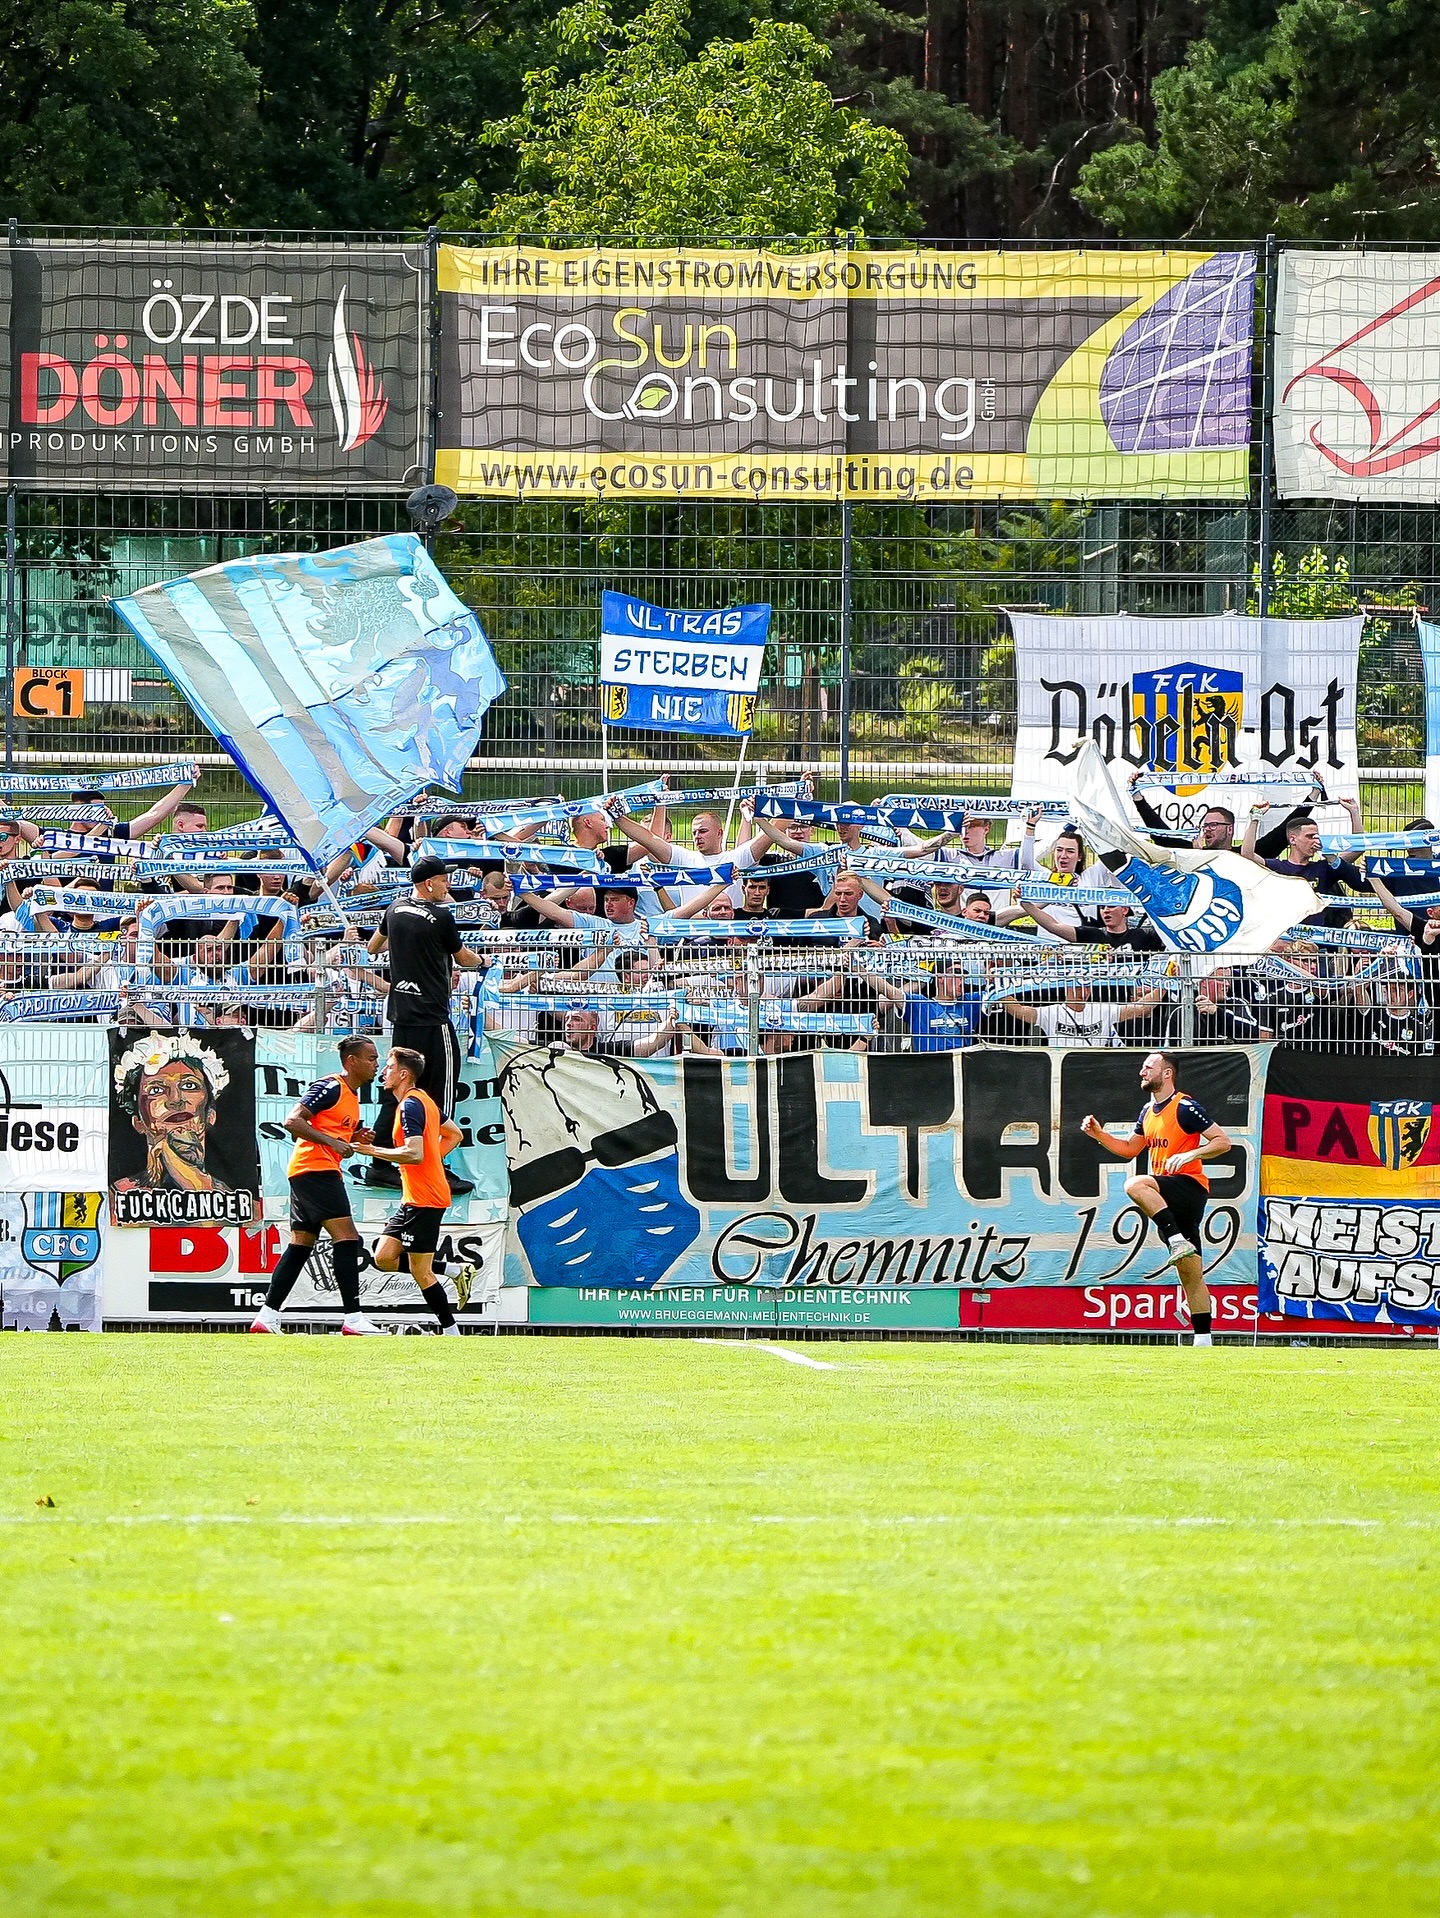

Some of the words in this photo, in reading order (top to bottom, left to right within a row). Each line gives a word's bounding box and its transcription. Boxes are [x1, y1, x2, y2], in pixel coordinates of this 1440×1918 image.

[481, 260, 549, 288] IHRE
[563, 259, 978, 290] EIGENSTROMVERSORGUNG
[142, 279, 294, 345] ÖZDE
[20, 334, 315, 427] DÖNER
[583, 360, 977, 441] Consulting
[981, 376, 996, 421] GmbH
[0, 433, 218, 454] PRODUKTIONS
[234, 435, 315, 454] GMBH
[480, 457, 975, 498] www.ecosun-consulting.de
[627, 604, 742, 635] ULTRAS
[32, 669, 68, 679] BLOCK
[614, 649, 748, 681] STERBEN
[20, 678, 72, 716] C1
[651, 694, 704, 722] NIE
[1378, 1102, 1424, 1116] FCK
[116, 1193, 171, 1219] FUCK
[172, 1192, 251, 1219] CANCER
[32, 1234, 89, 1257] CFC
[712, 1211, 1032, 1285] Chemnitz
[578, 1287, 610, 1303] IHR
[713, 1288, 749, 1303] FÜR
[1277, 1251, 1440, 1308] AUFS
[617, 1309, 871, 1323] WWW.BRUEGGEMANN-MEDIENTECHNIK.DE
[1083, 1287, 1284, 1326] Sparkss
